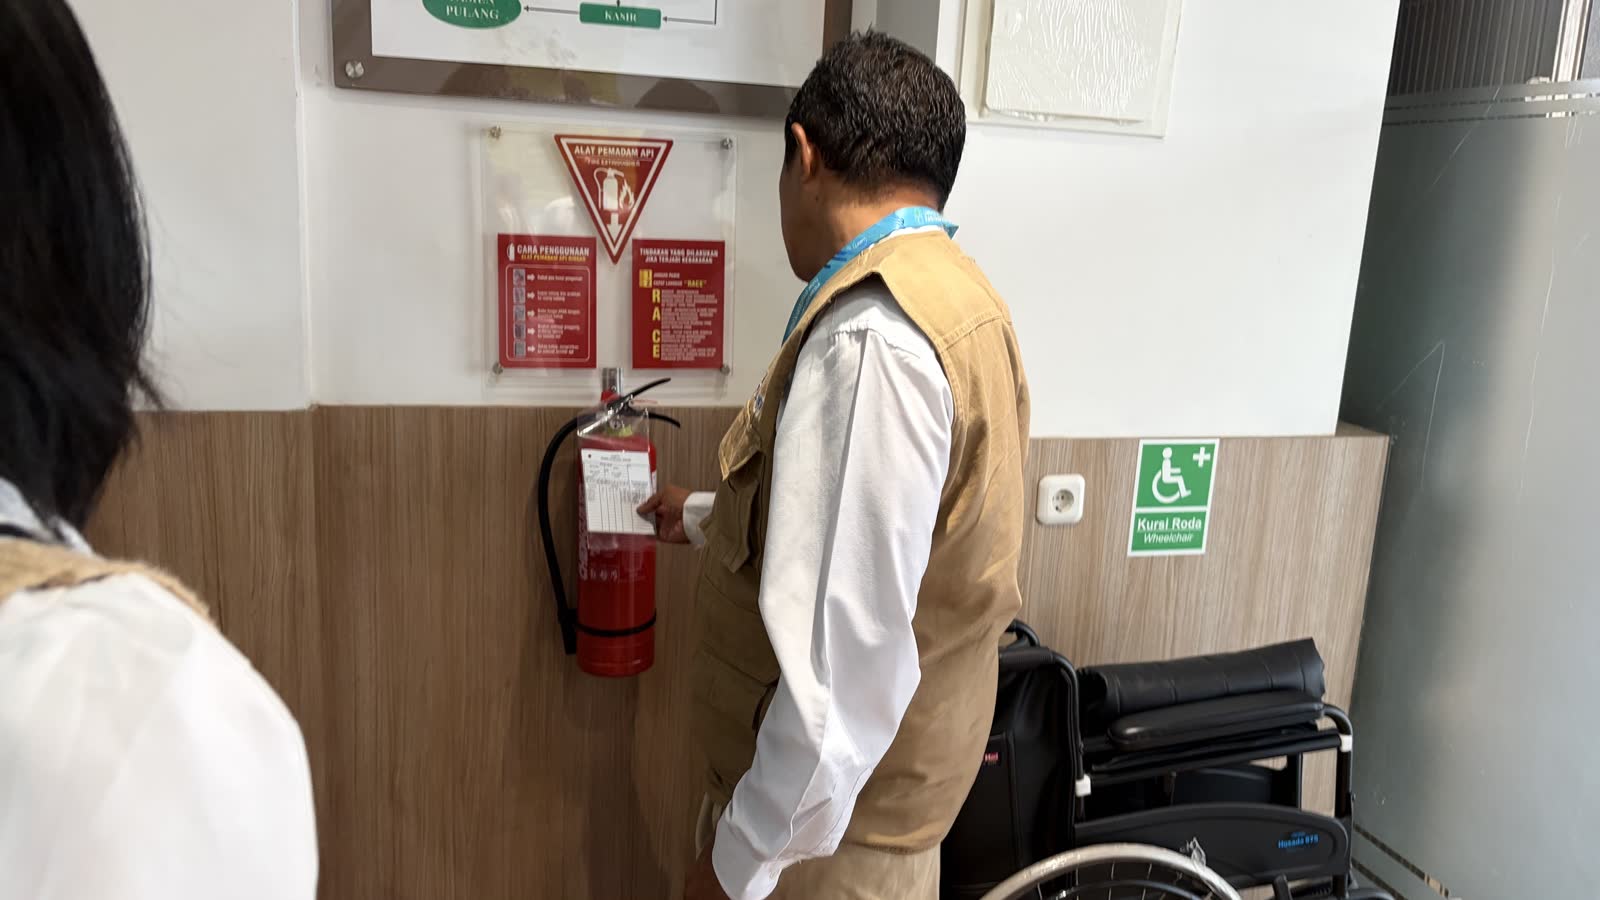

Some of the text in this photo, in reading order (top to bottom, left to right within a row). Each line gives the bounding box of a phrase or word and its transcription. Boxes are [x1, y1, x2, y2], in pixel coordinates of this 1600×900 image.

[446, 5, 499, 20] PULANG
[604, 10, 637, 23] KASIR
[574, 145, 655, 159] ALAT PEMADAM API
[517, 244, 590, 257] CARA PENGGUNAAN
[652, 288, 661, 304] R
[652, 306, 661, 321] A
[652, 329, 661, 344] C
[652, 344, 661, 358] E
[1137, 516, 1202, 532] Kursi Roda
[1143, 531, 1194, 544] Wheelchair
